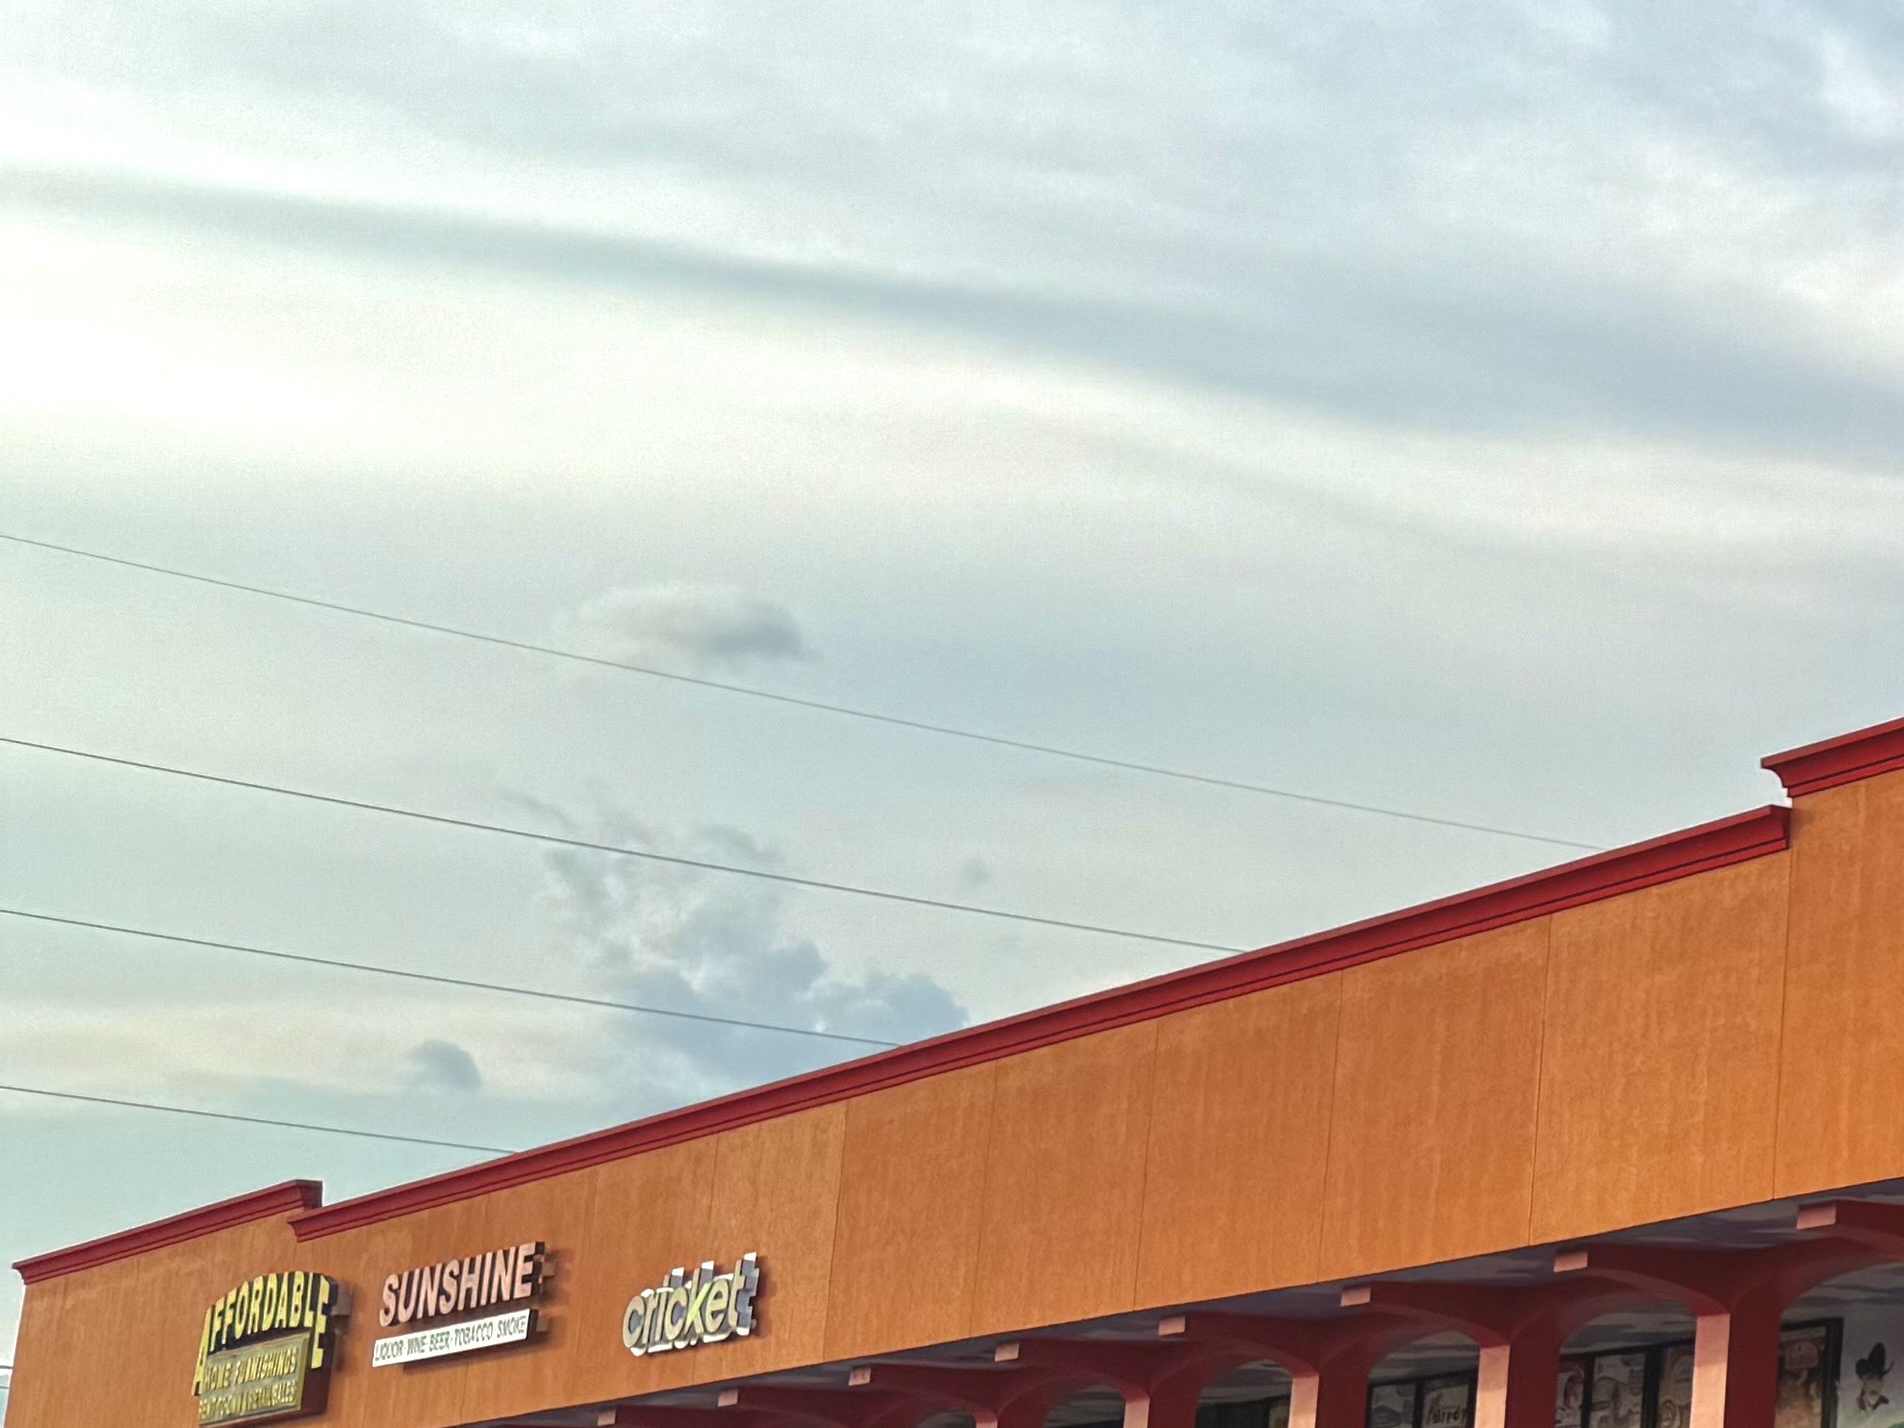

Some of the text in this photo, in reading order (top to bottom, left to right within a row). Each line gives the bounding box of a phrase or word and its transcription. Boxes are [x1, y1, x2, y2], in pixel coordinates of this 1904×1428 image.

[379, 1241, 537, 1327] SUNSHINE
[622, 1256, 752, 1352] cricket
[191, 1270, 331, 1396] AFFORDABLE
[203, 1361, 232, 1389] HOME
[454, 1322, 494, 1347] TOBACCO
